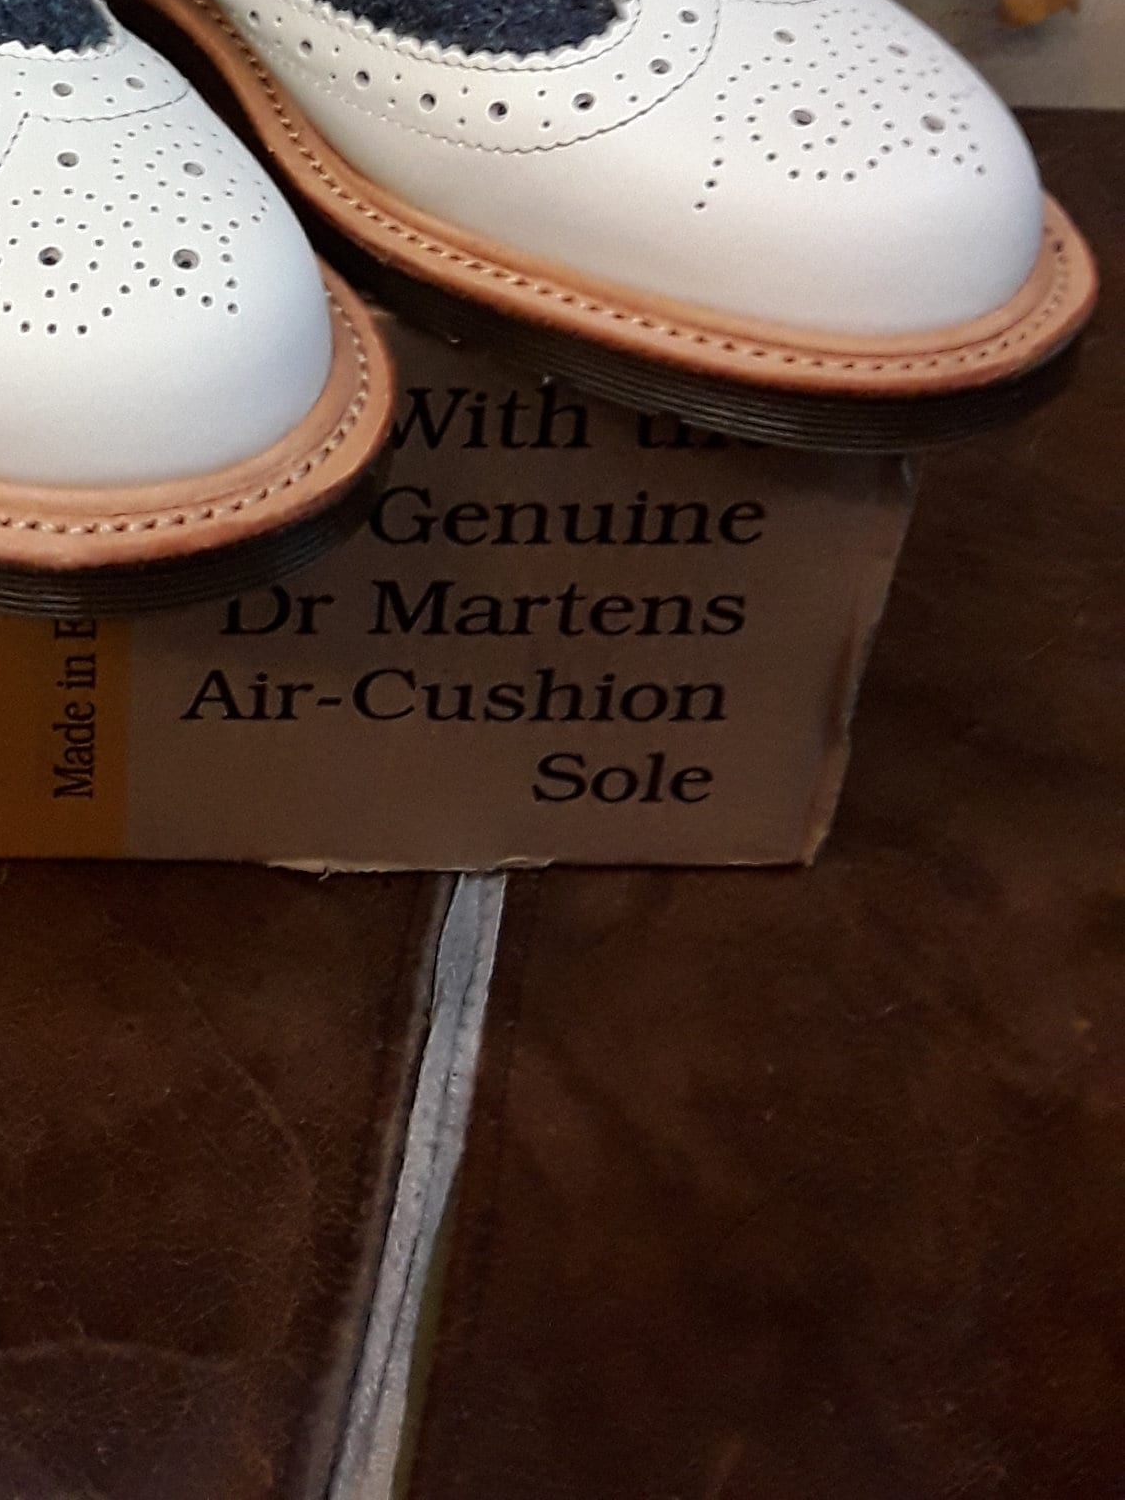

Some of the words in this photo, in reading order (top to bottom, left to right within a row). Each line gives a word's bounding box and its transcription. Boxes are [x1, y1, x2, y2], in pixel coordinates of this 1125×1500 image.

[391, 385, 593, 450] With
[370, 485, 768, 546] Genuine
[220, 588, 335, 636] Dr
[369, 579, 747, 636] Martens
[56, 653, 97, 690] in
[180, 667, 728, 723] Air-Cushion
[52, 700, 97, 799] Made
[530, 752, 714, 805] Sole
